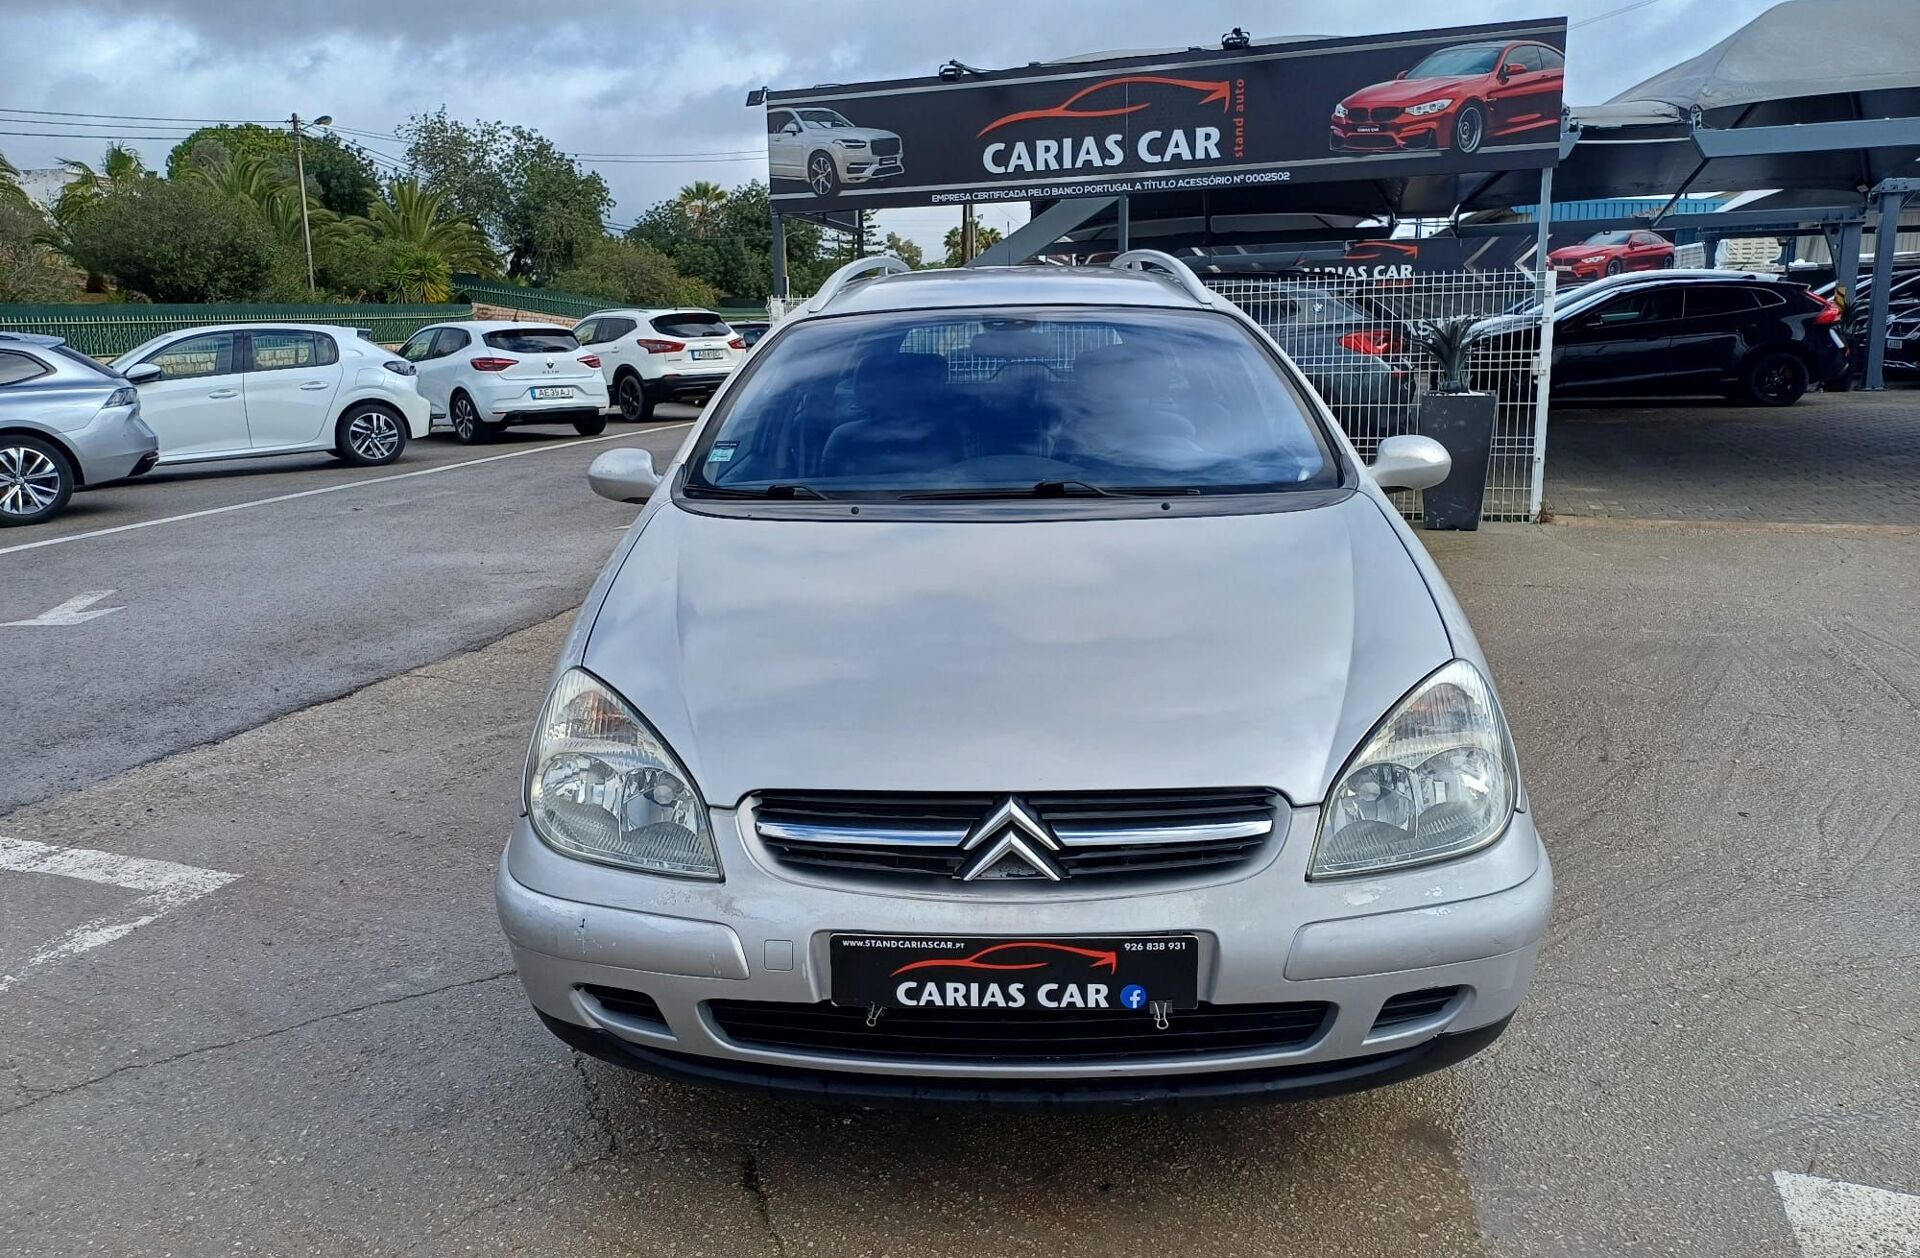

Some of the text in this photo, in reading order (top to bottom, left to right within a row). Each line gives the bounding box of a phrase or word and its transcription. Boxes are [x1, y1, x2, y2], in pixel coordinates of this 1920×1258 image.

[1232, 79, 1245, 158] stand auto
[982, 126, 1221, 174] CARIAS CAR
[931, 193, 972, 203] EMPRESA
[972, 189, 1027, 200] CERTIFICADA
[1028, 187, 1051, 197] PELO
[1051, 185, 1084, 196] BANCO
[1084, 181, 1133, 194] PORTUGAL
[1134, 181, 1142, 190] A
[1143, 177, 1176, 189] TÍTULO
[1177, 175, 1232, 188] ACESSÓRIO
[1245, 171, 1291, 183] 0002502
[1373, 264, 1413, 279] CAR
[1124, 941, 1186, 951] 926 838 931
[896, 981, 1110, 1009] CARIAS CAR
